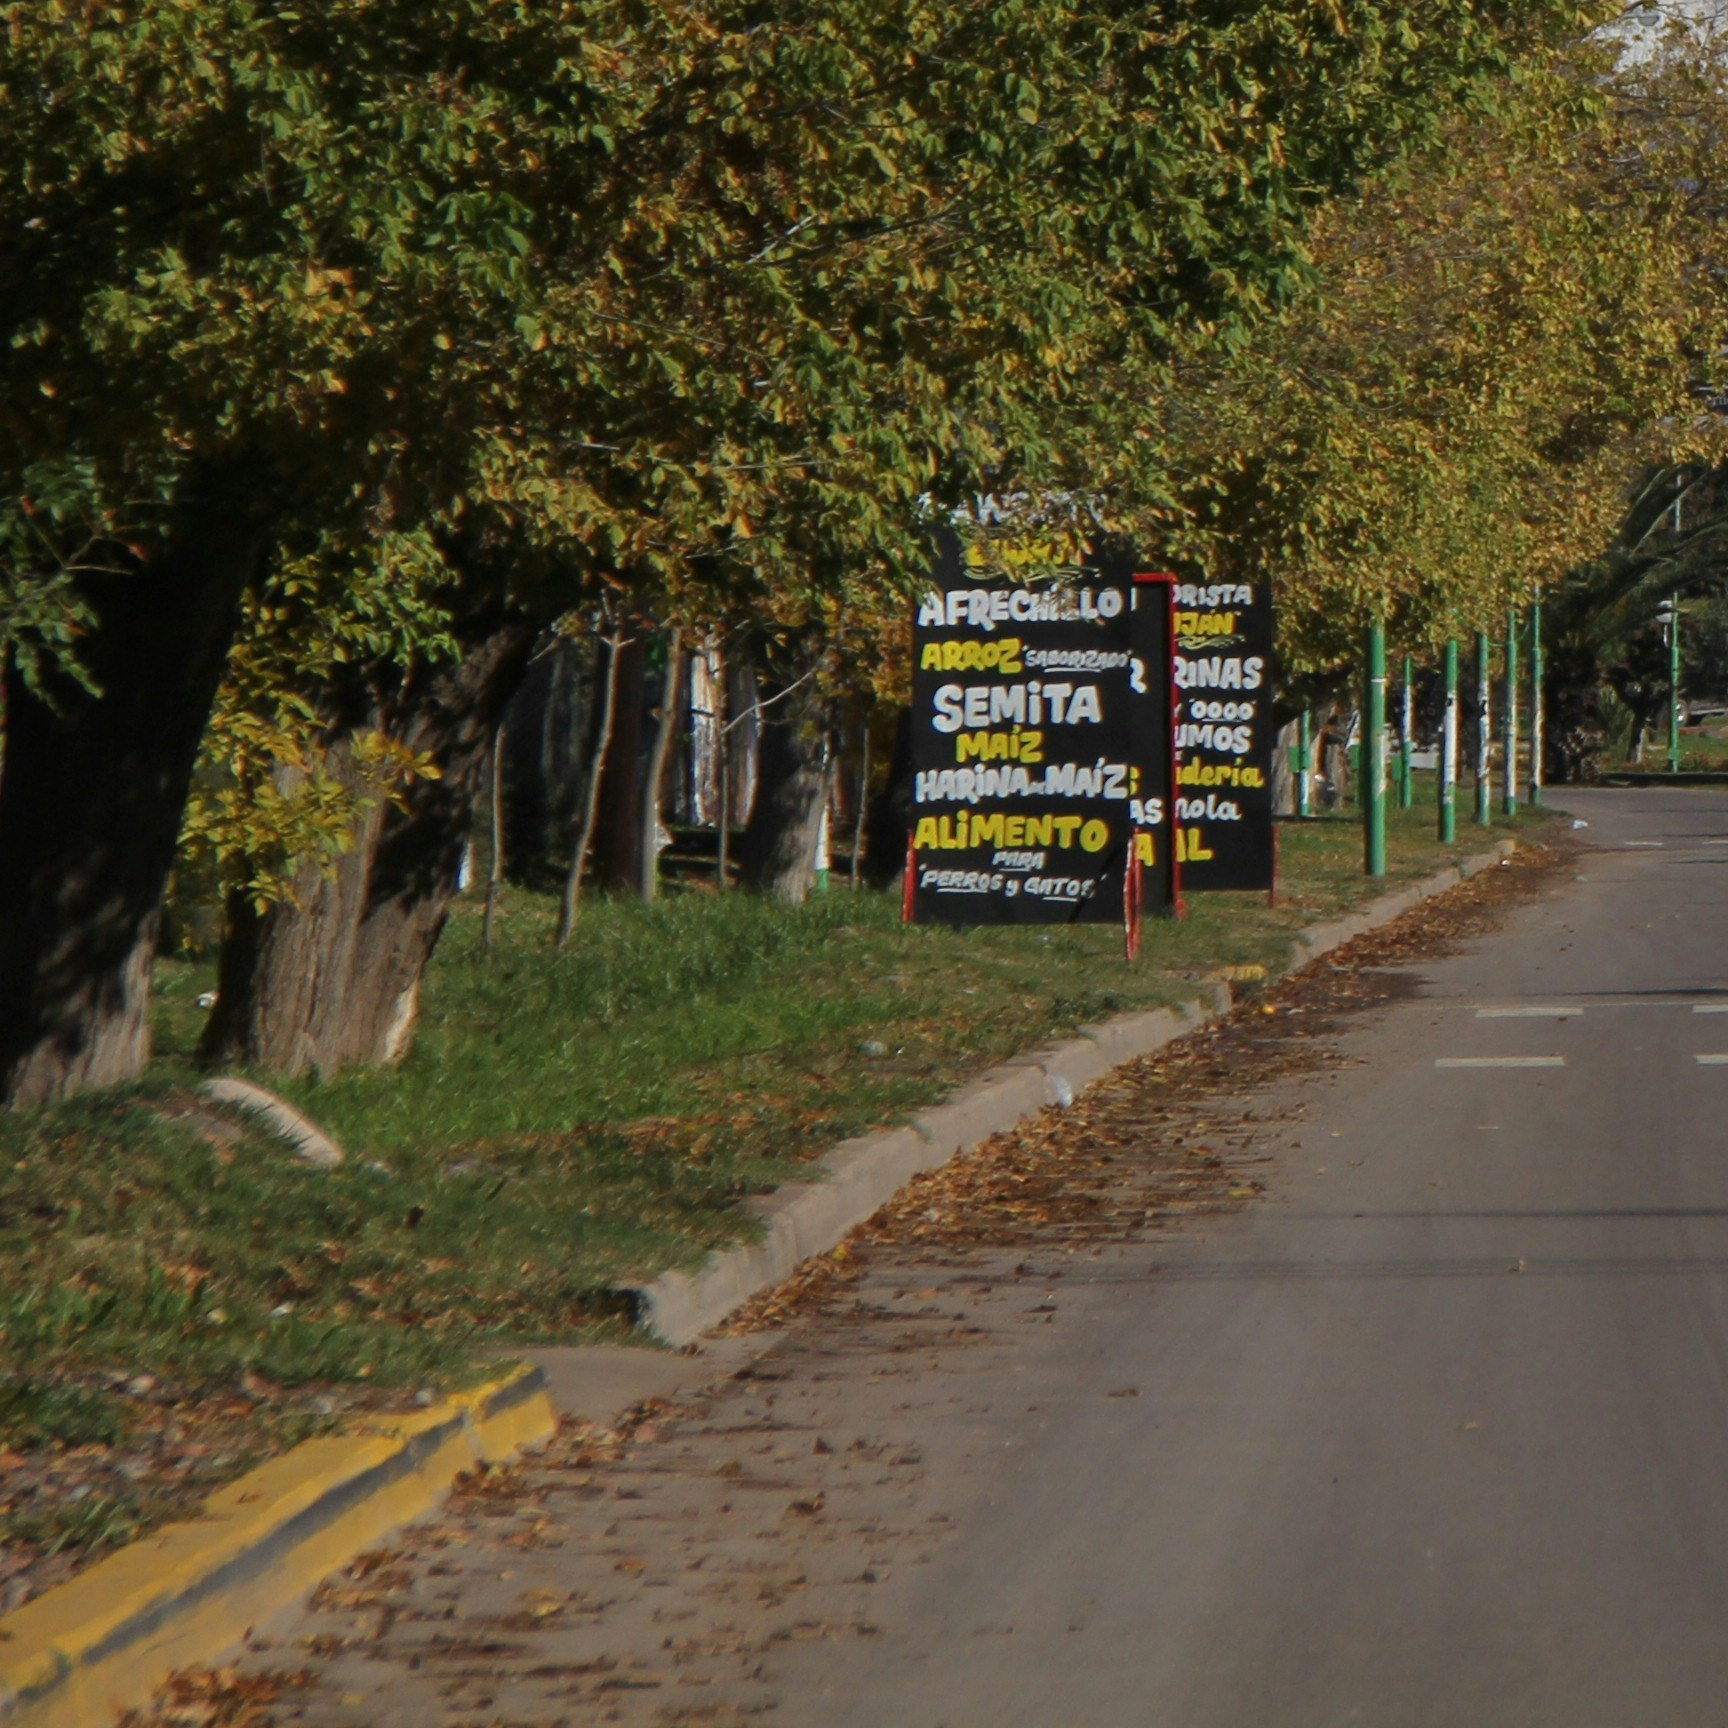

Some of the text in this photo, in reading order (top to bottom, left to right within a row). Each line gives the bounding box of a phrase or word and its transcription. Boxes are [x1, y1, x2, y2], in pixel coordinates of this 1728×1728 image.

[920, 637, 1024, 674] ARROZ
[955, 724, 1045, 764] MAÍZ
[1044, 756, 1129, 800] MAÍZ
[991, 851, 1046, 872] PARA
